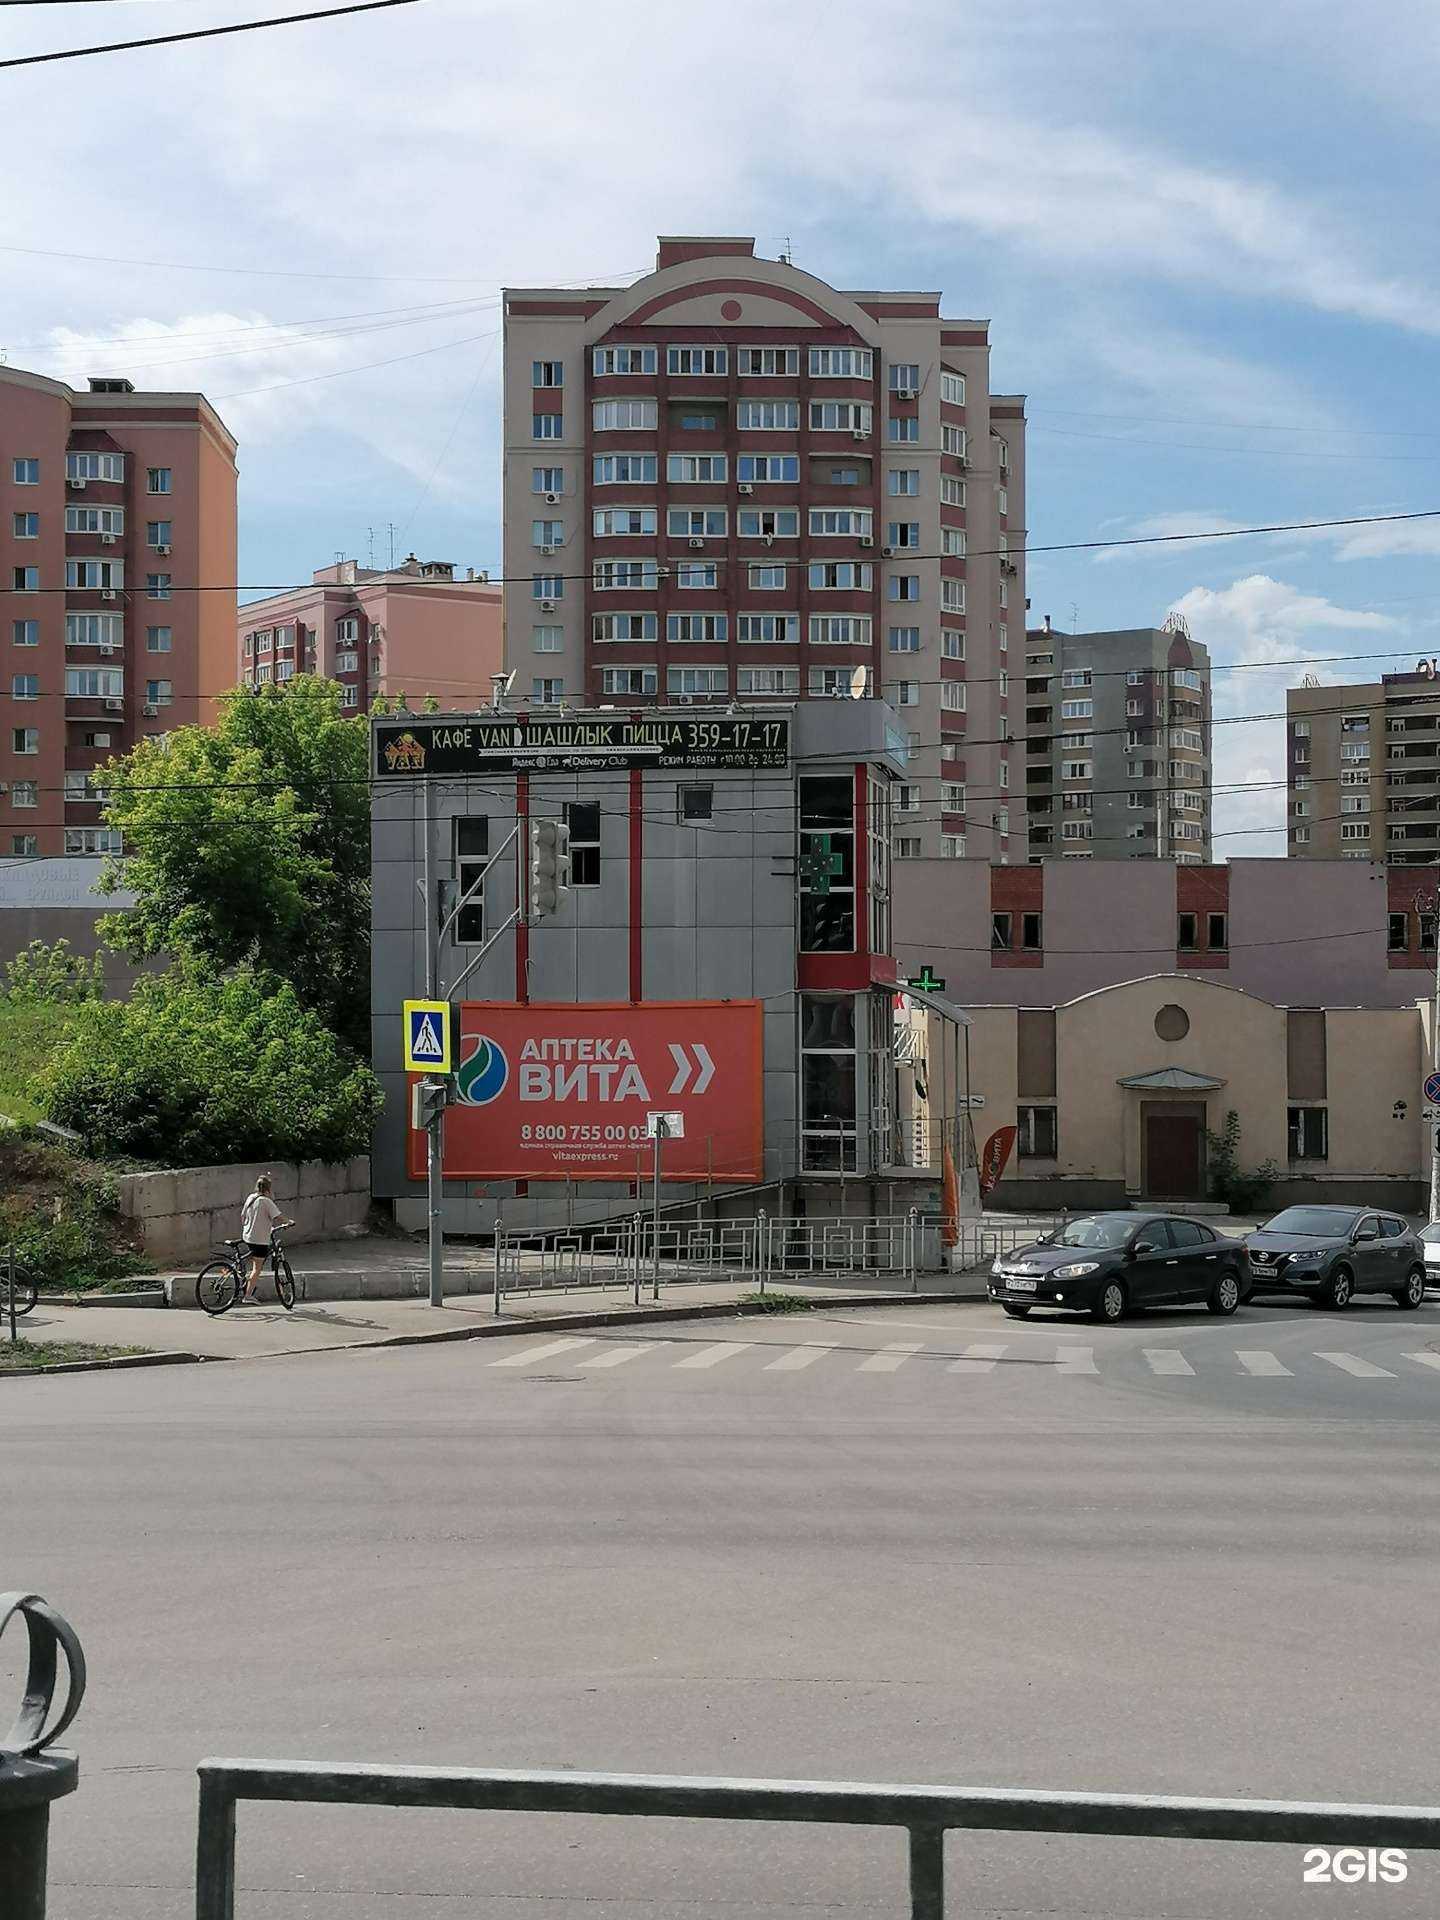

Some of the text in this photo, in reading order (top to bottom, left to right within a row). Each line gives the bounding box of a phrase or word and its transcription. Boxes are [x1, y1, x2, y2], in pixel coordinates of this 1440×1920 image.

[431, 728, 472, 749] КАФЕ
[526, 723, 781, 748] ШАШЛЫК ПИЦЦА 359-17-17
[572, 756, 628, 768] Delivery Club
[520, 1038, 635, 1060] АПТЕКА
[519, 1064, 651, 1102] ВИТА
[521, 1125, 532, 1140] 8
[535, 1125, 566, 1140] 800
[570, 1125, 601, 1140] 755
[605, 1125, 626, 1140] 00
